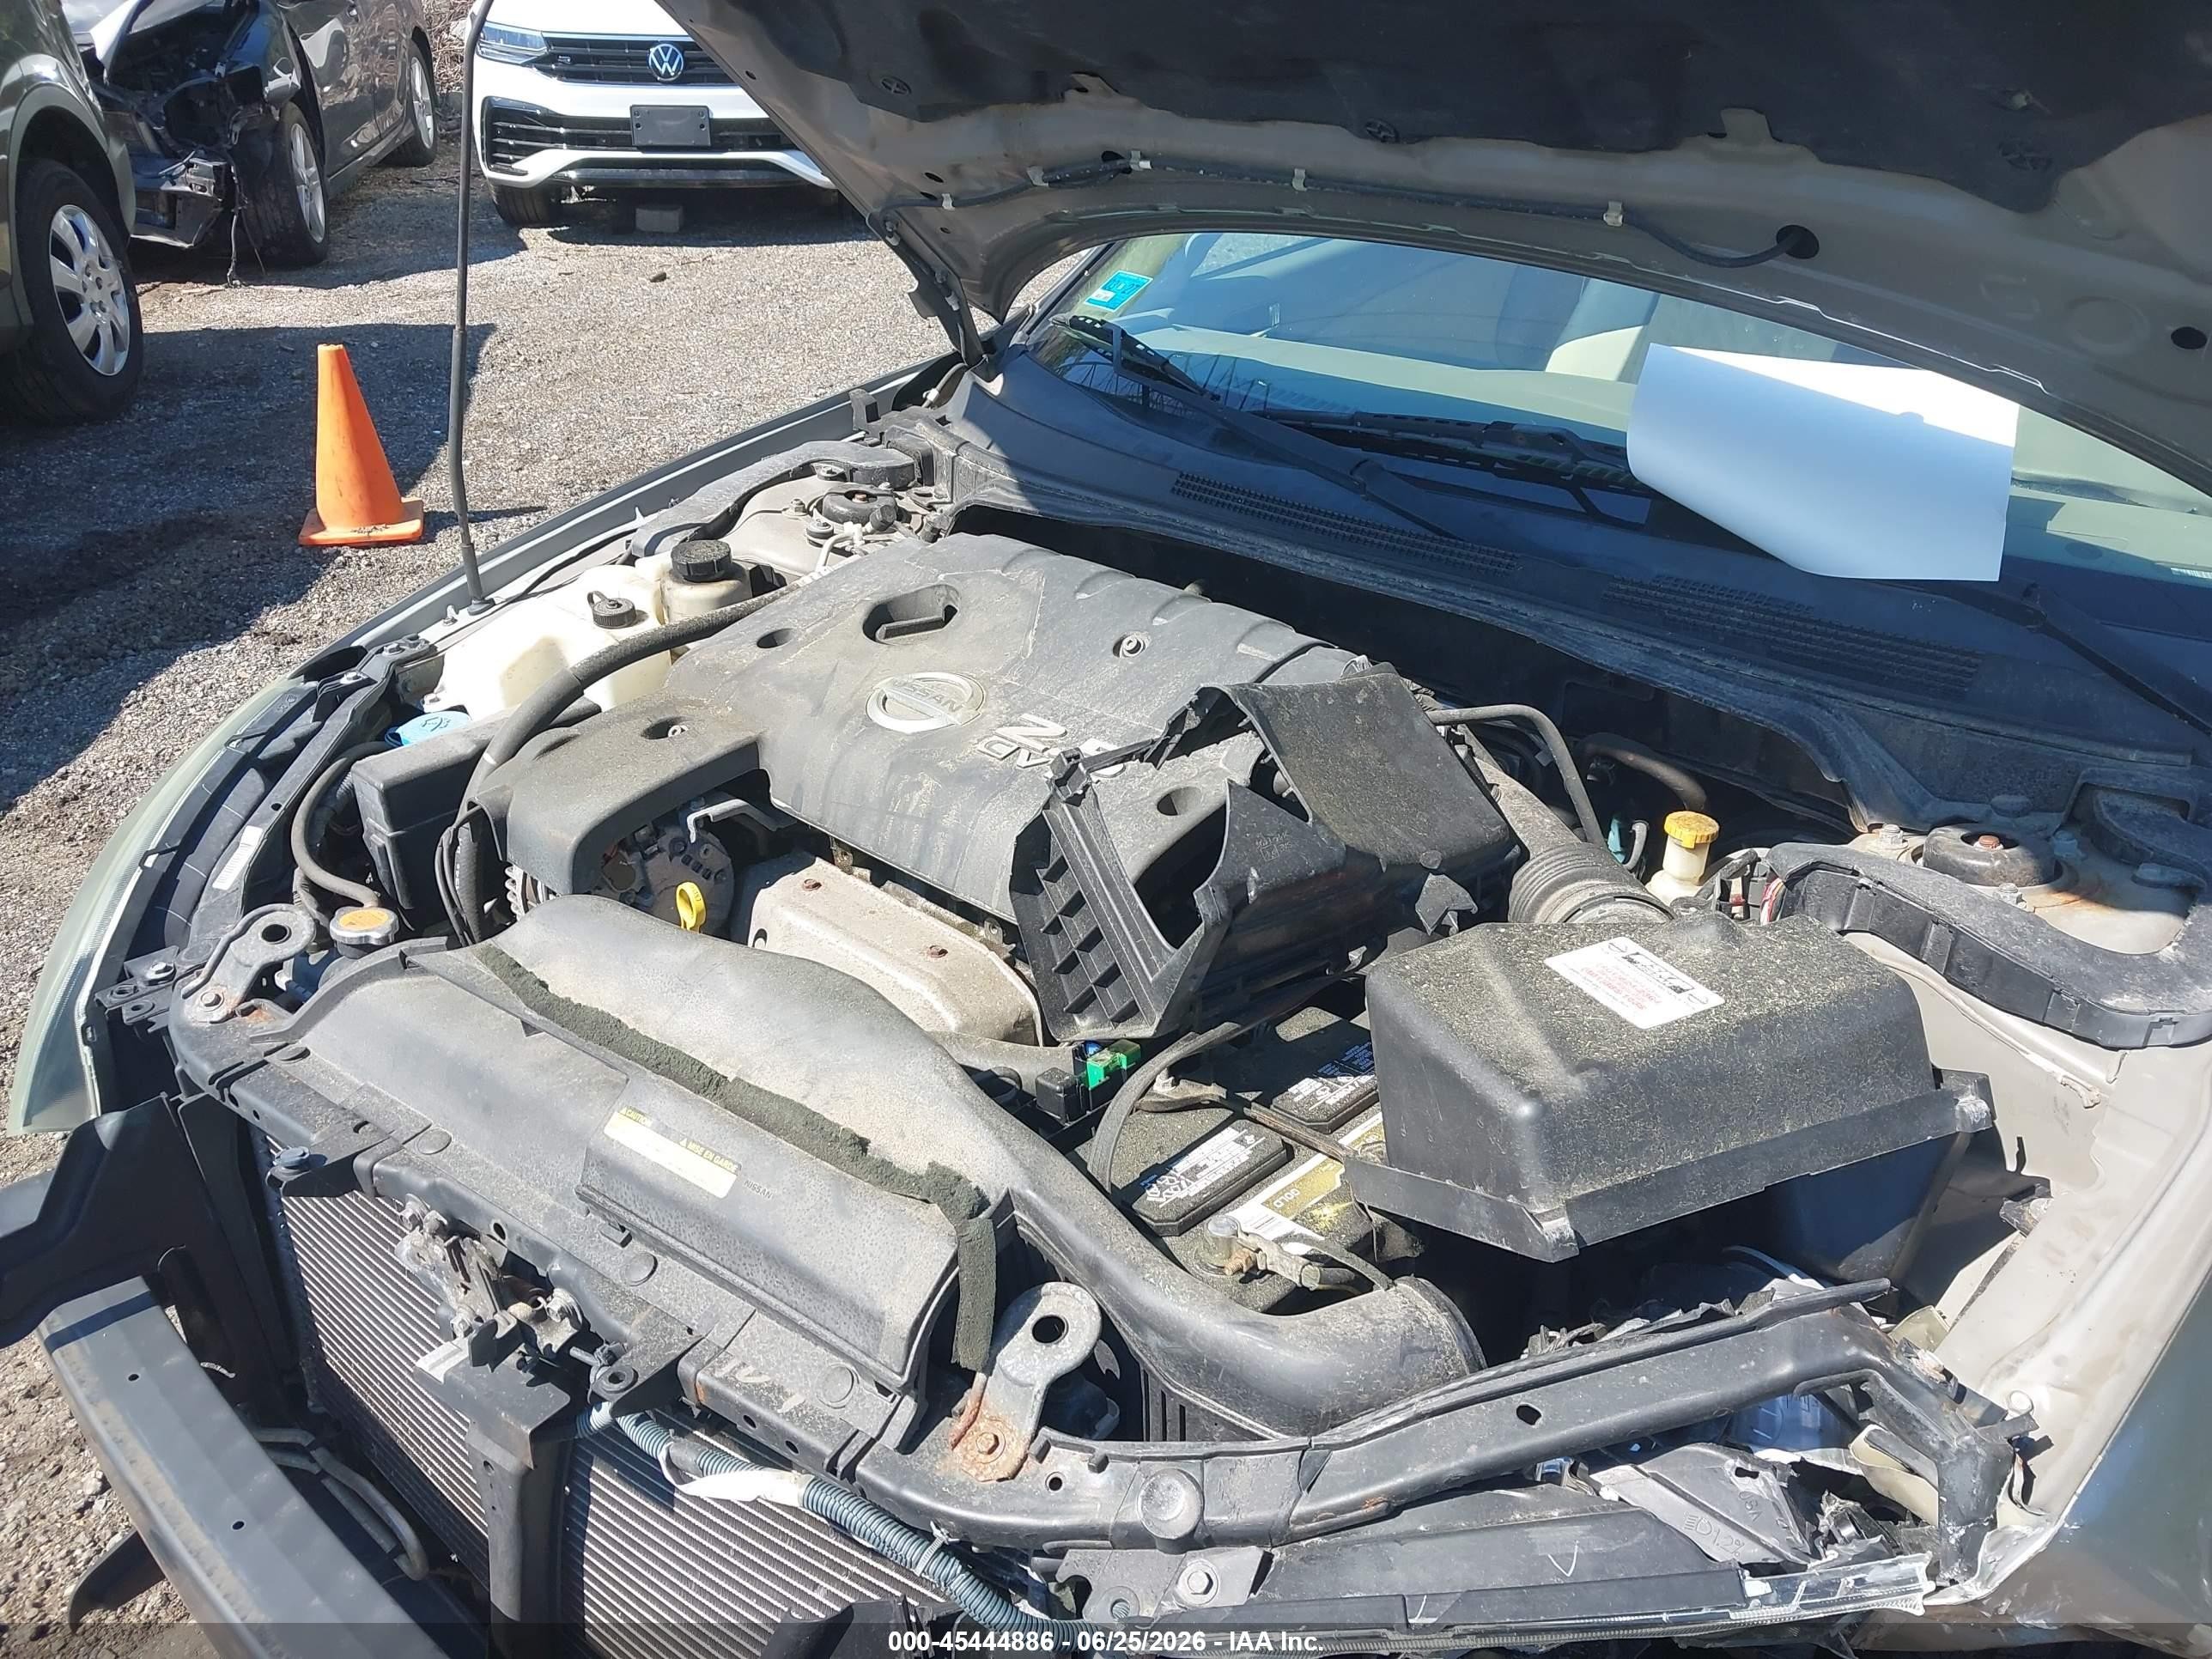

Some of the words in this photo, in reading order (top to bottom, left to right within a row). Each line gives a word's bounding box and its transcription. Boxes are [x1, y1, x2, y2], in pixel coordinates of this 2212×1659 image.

[626, 1109, 653, 1127] CAUTION
[687, 1140, 705, 1156] MISE
[702, 1150, 715, 1162] EN
[713, 1155, 738, 1173] GARDE
[744, 1180, 773, 1200] NISSAN
[1273, 1188, 1301, 1208] GOLD
